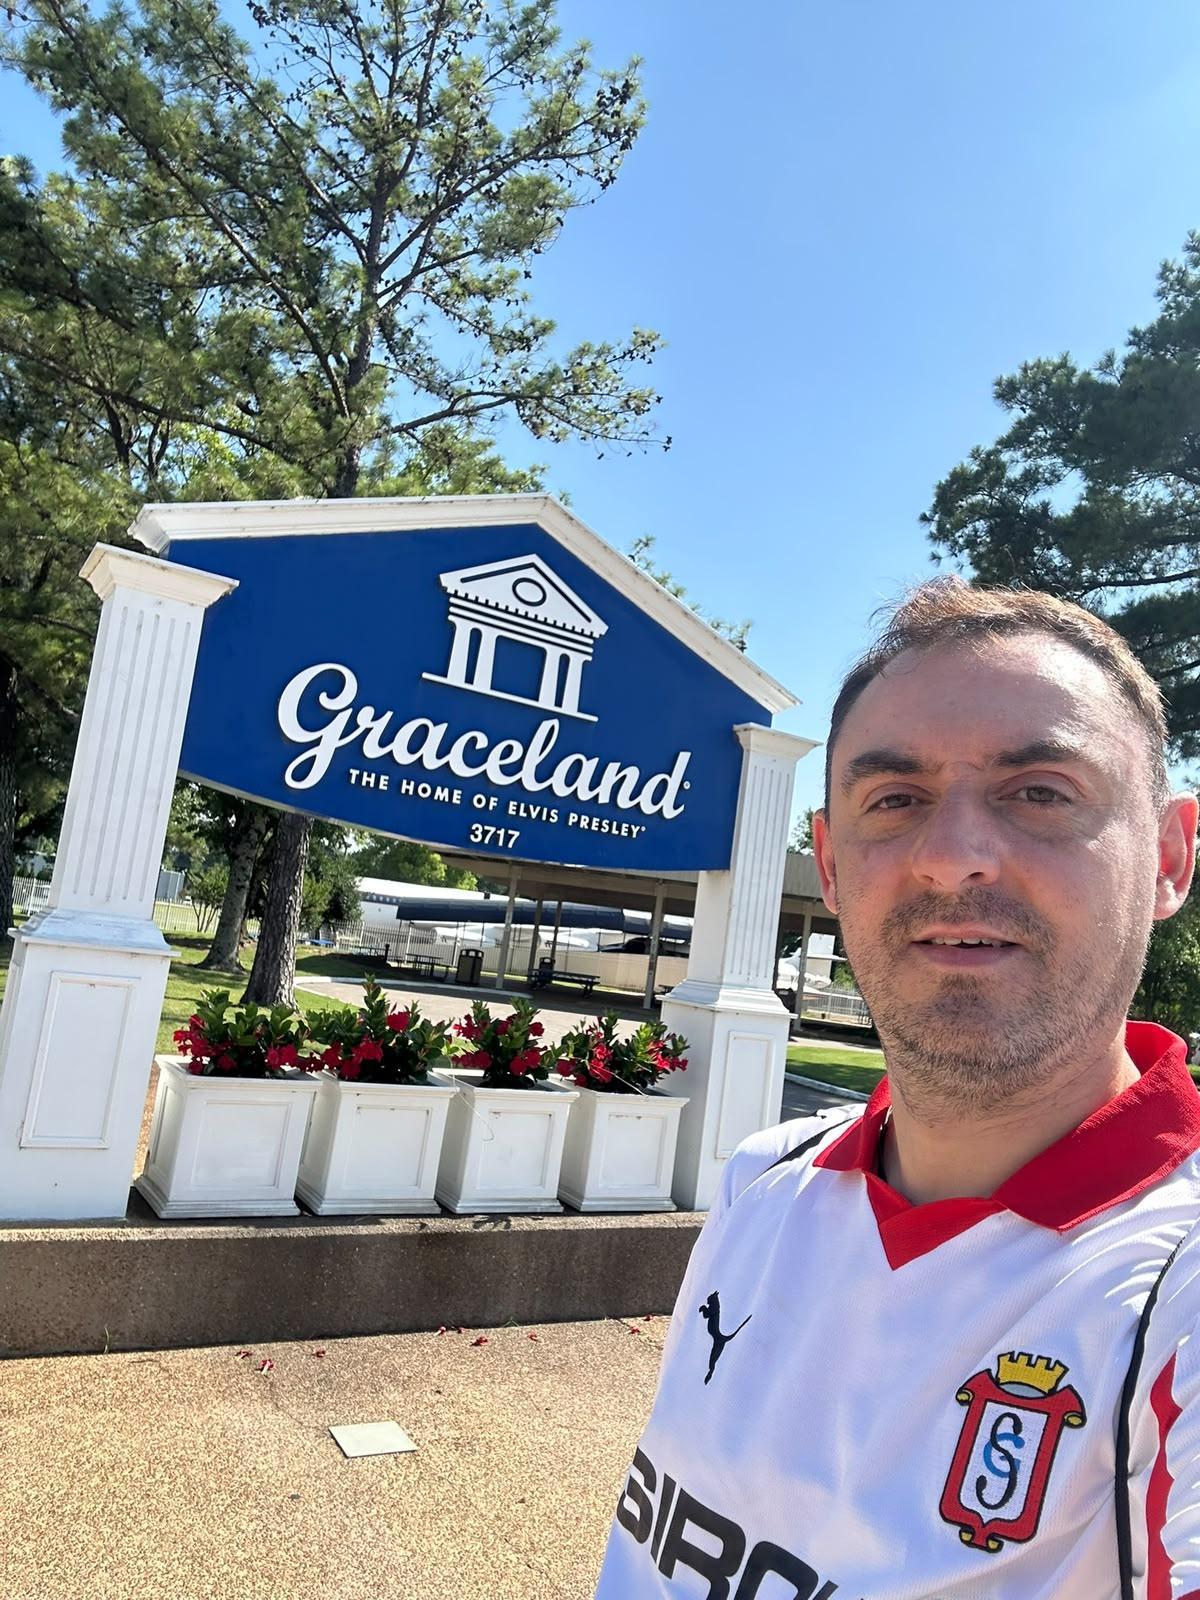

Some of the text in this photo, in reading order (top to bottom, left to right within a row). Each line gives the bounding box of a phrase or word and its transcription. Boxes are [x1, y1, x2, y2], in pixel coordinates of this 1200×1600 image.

[349, 768, 390, 790] THE
[401, 779, 462, 805] HOME
[472, 793, 499, 811] OF
[507, 801, 559, 823] ELVIS
[470, 823, 520, 849] 3717
